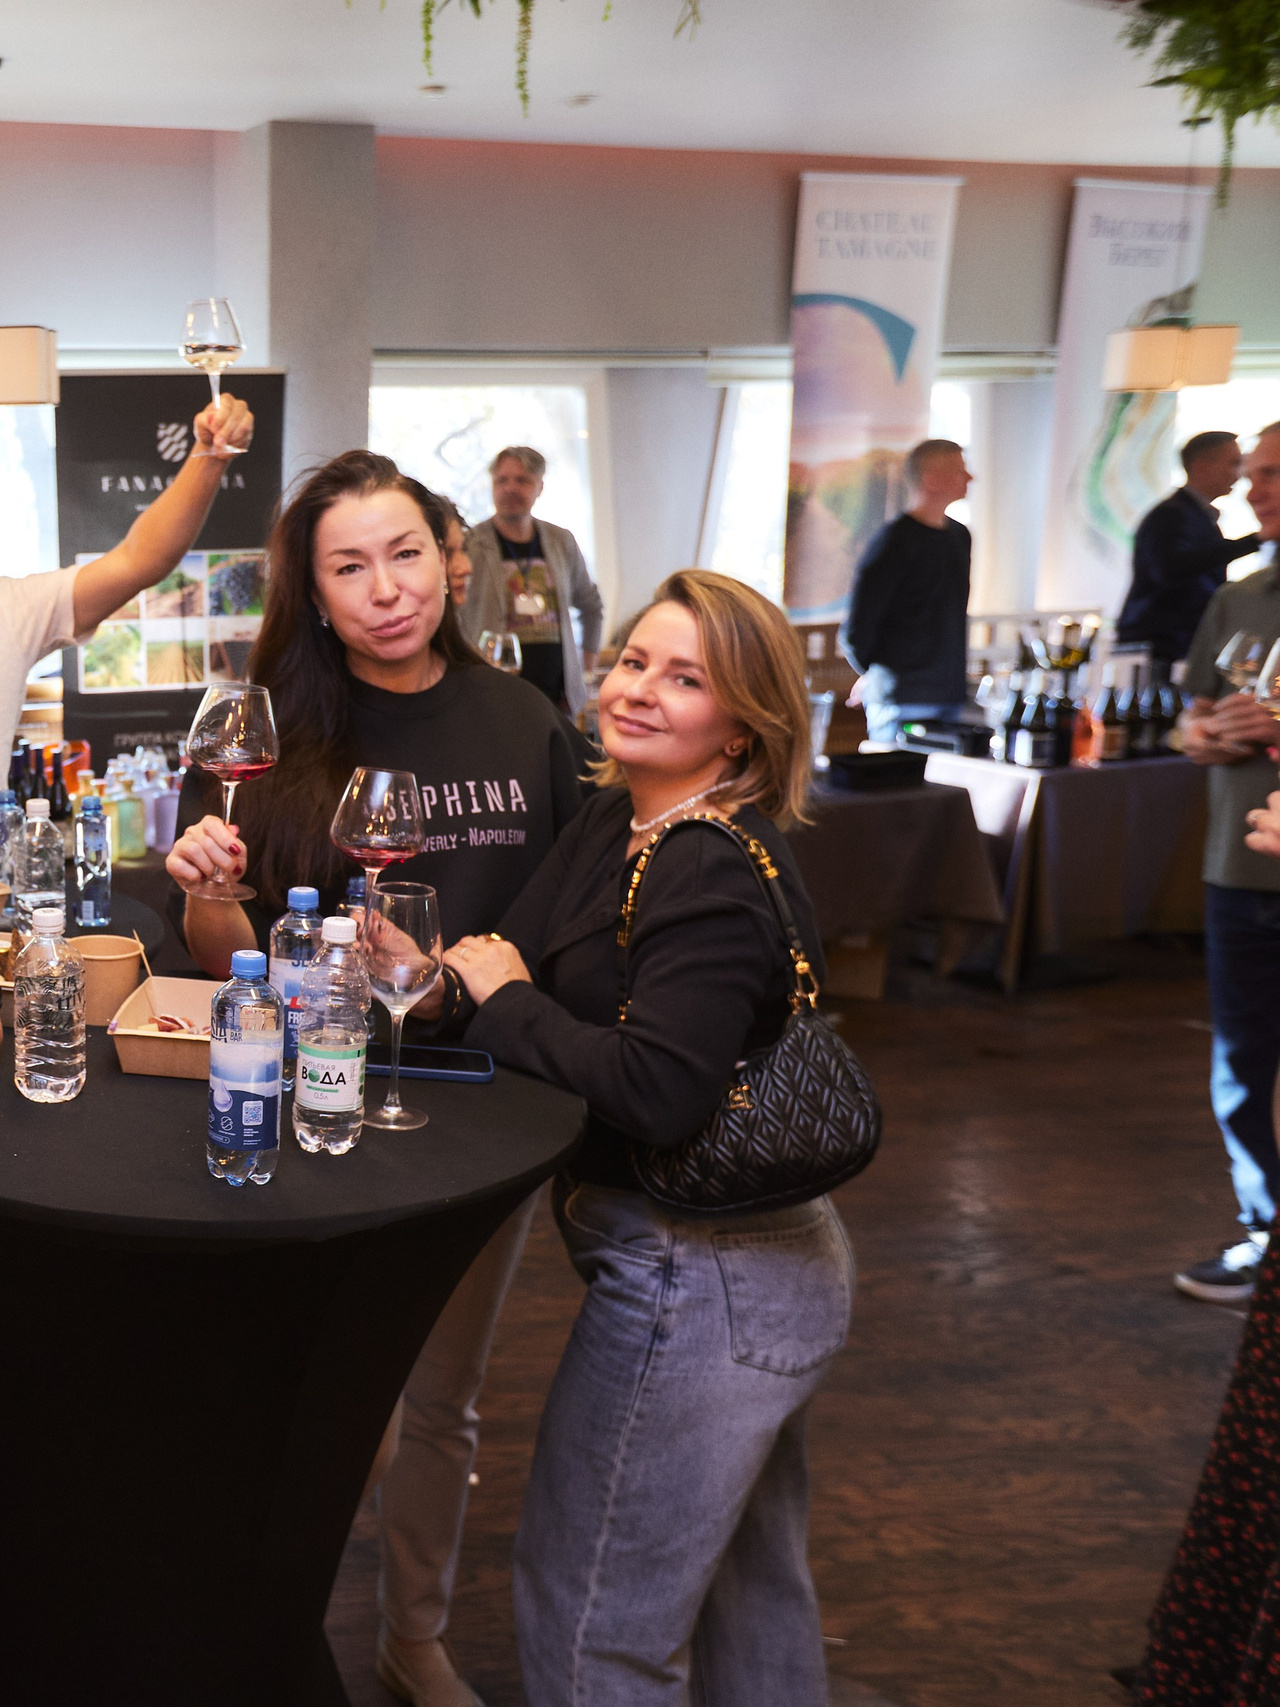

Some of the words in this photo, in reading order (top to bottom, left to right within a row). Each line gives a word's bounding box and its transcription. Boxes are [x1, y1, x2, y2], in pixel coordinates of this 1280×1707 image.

[101, 473, 246, 493] FANAIA
[468, 827, 526, 847] NAPOLEON
[229, 1031, 243, 1042] BAR
[301, 1065, 347, 1086] ВОДА
[302, 1059, 336, 1072] ПИТЬЕВАЯ
